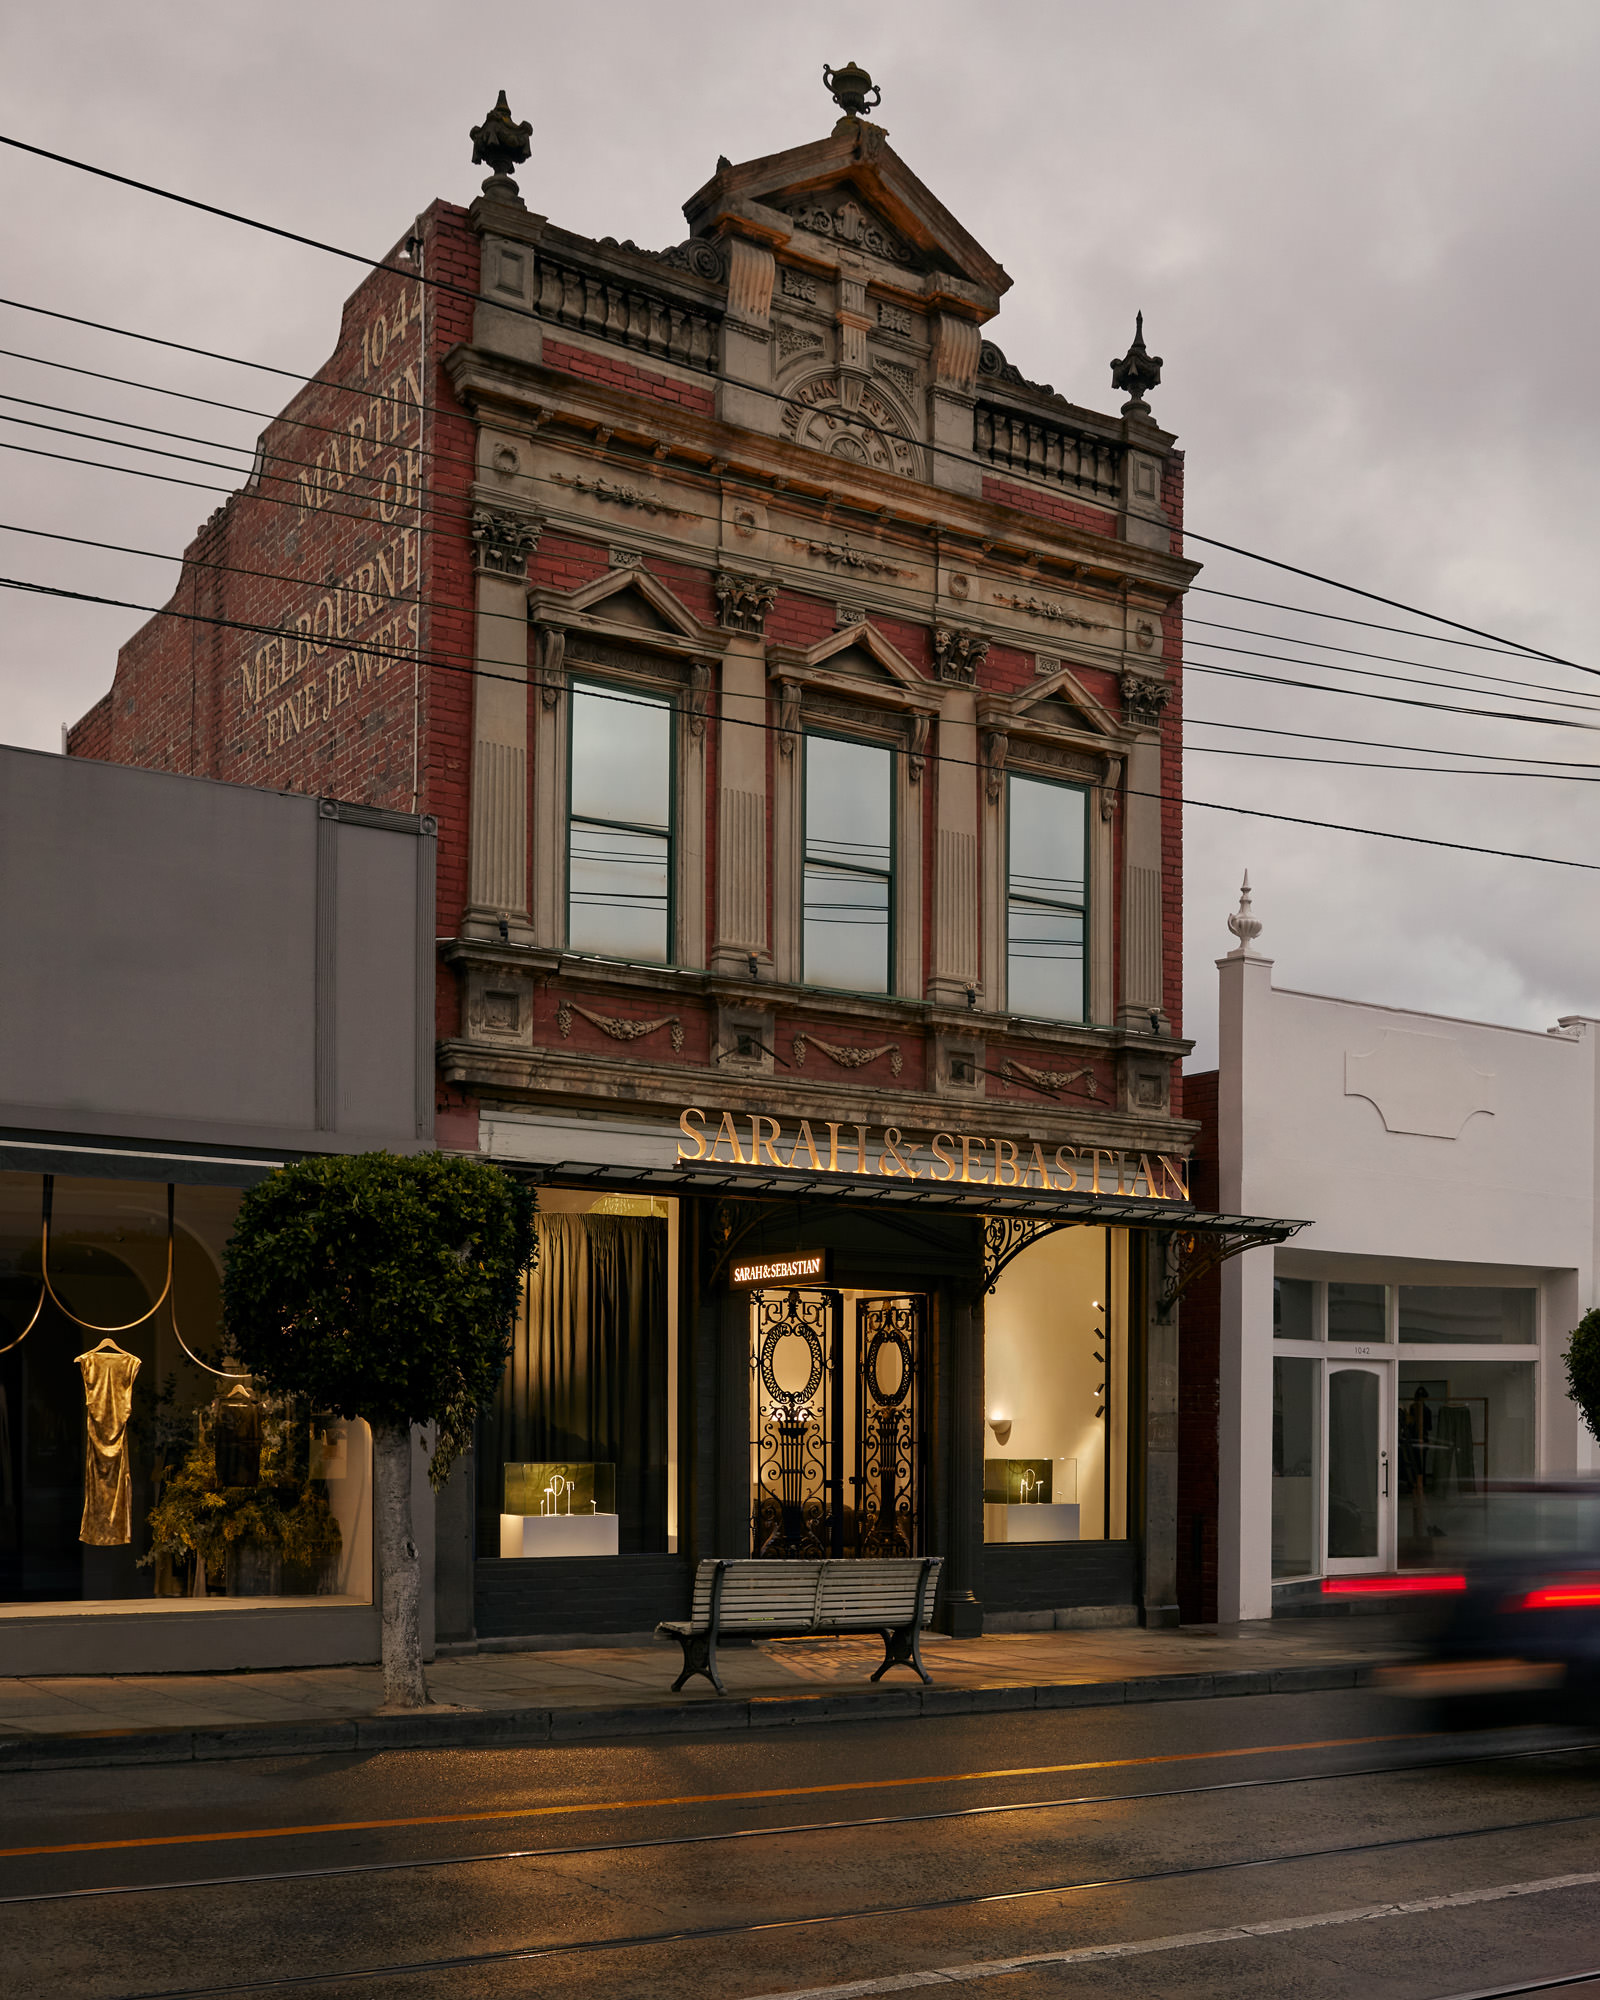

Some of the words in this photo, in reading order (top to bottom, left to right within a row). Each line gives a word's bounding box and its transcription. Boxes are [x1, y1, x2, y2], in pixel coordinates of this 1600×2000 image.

[361, 281, 424, 379] 1044
[297, 361, 423, 526] MARTIN
[379, 440, 421, 523] OF
[240, 521, 420, 715] MELBOURNE
[265, 679, 318, 756] FINE
[321, 604, 419, 722] JEWELS
[1354, 1346, 1371, 1355] 1042
